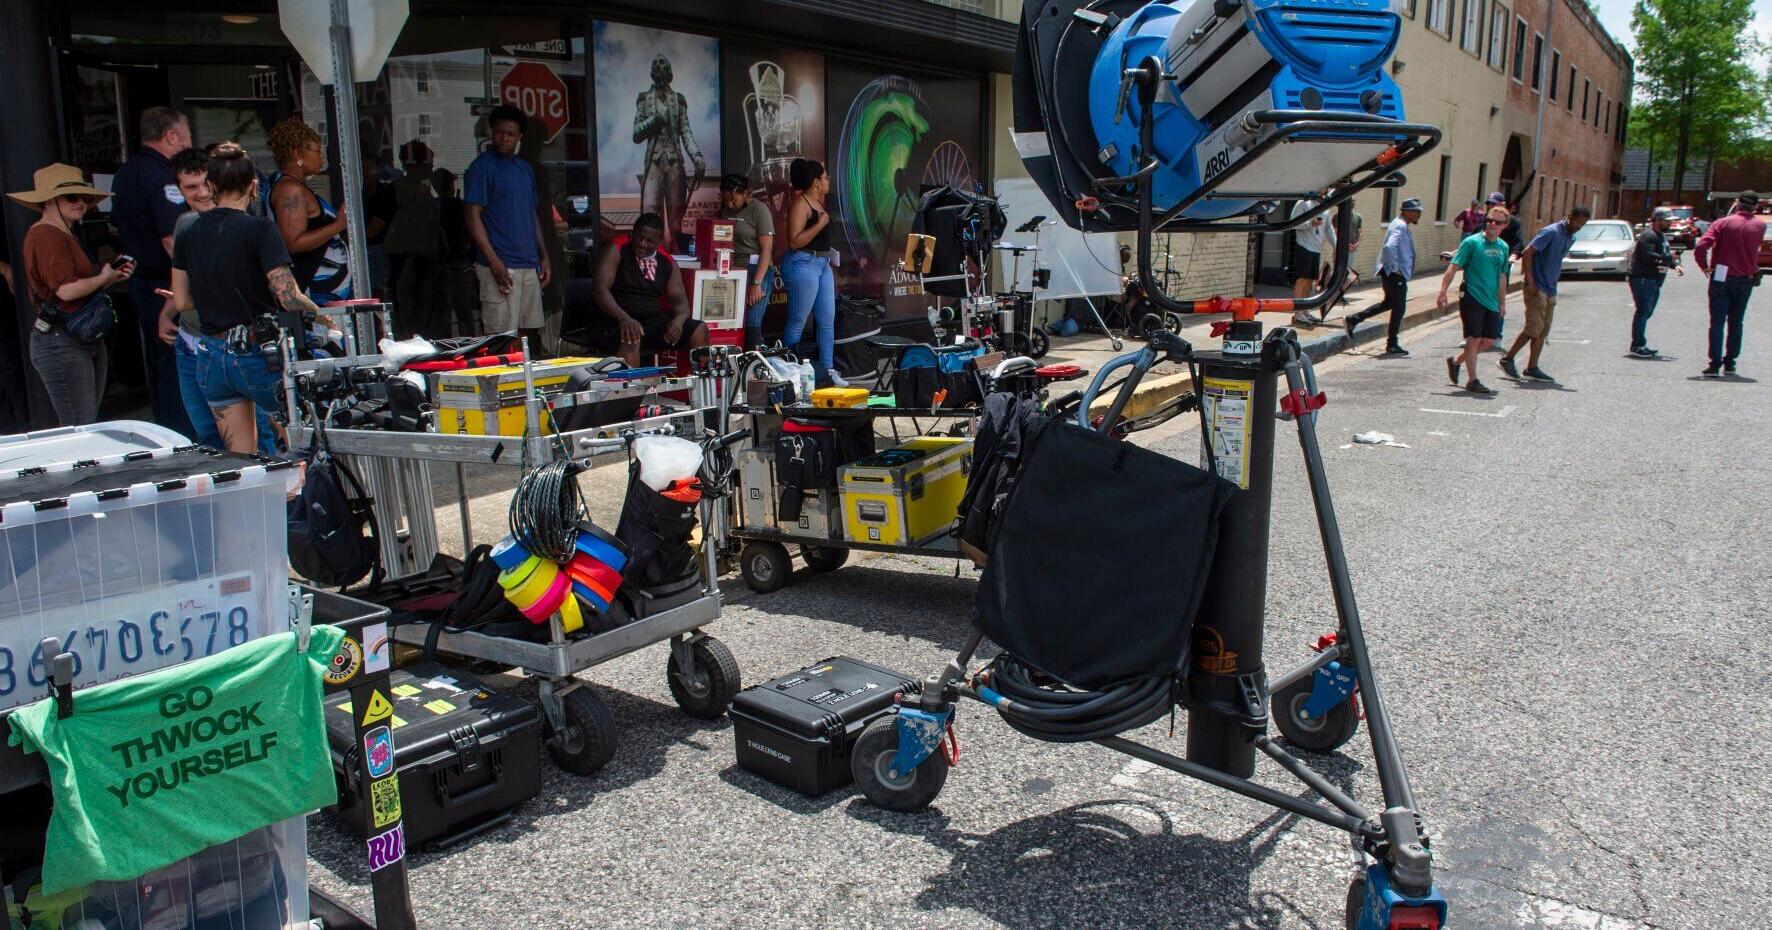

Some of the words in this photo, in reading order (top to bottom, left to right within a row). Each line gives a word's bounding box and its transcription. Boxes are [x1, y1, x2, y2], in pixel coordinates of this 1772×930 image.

[249, 71, 278, 99] THE
[1203, 147, 1230, 182] ARRI
[329, 661, 358, 680] RECORDS
[160, 686, 213, 719] GO
[111, 702, 266, 769] THWOCK
[106, 732, 278, 808] YOURSELF
